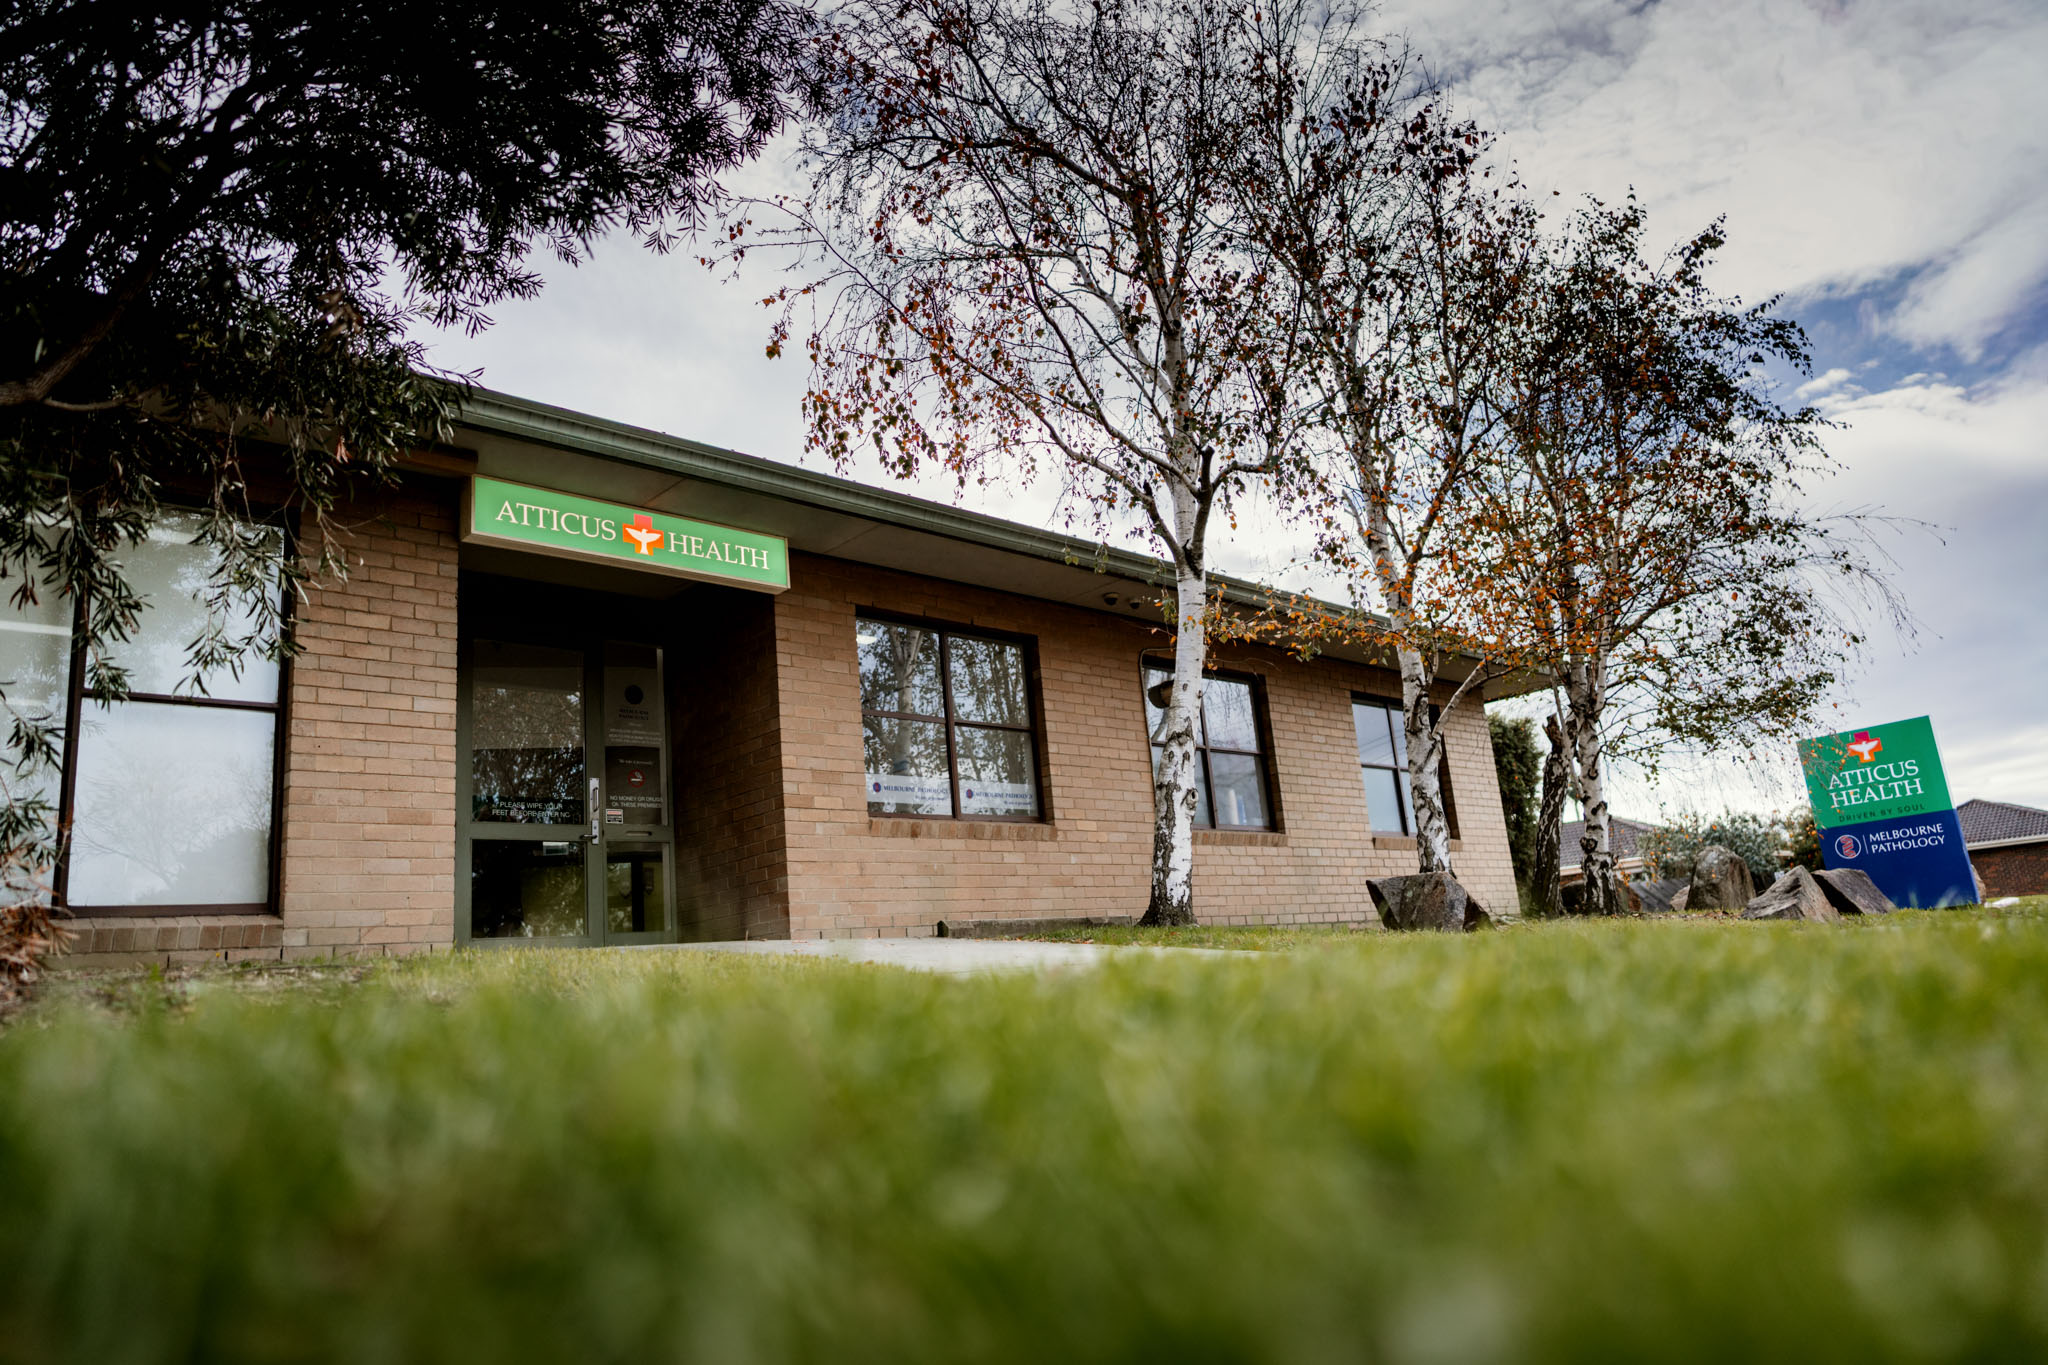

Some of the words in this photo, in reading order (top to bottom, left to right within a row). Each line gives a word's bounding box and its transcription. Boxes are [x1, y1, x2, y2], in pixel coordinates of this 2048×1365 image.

[495, 500, 616, 541] ATTICUS
[668, 531, 770, 570] HEALTH
[1828, 760, 1919, 790] ATTICUS
[1830, 778, 1924, 808] HEALTH
[500, 801, 525, 809] PLEASE
[526, 802, 543, 810] WIPE
[510, 810, 536, 818] BEFORE
[1839, 810, 1876, 823] DRIVEN
[1880, 808, 1893, 816] BY
[1897, 803, 1925, 815] SOUL
[1869, 823, 1944, 842] MELBOURNE
[1871, 835, 1945, 854] PATHOLOGY
